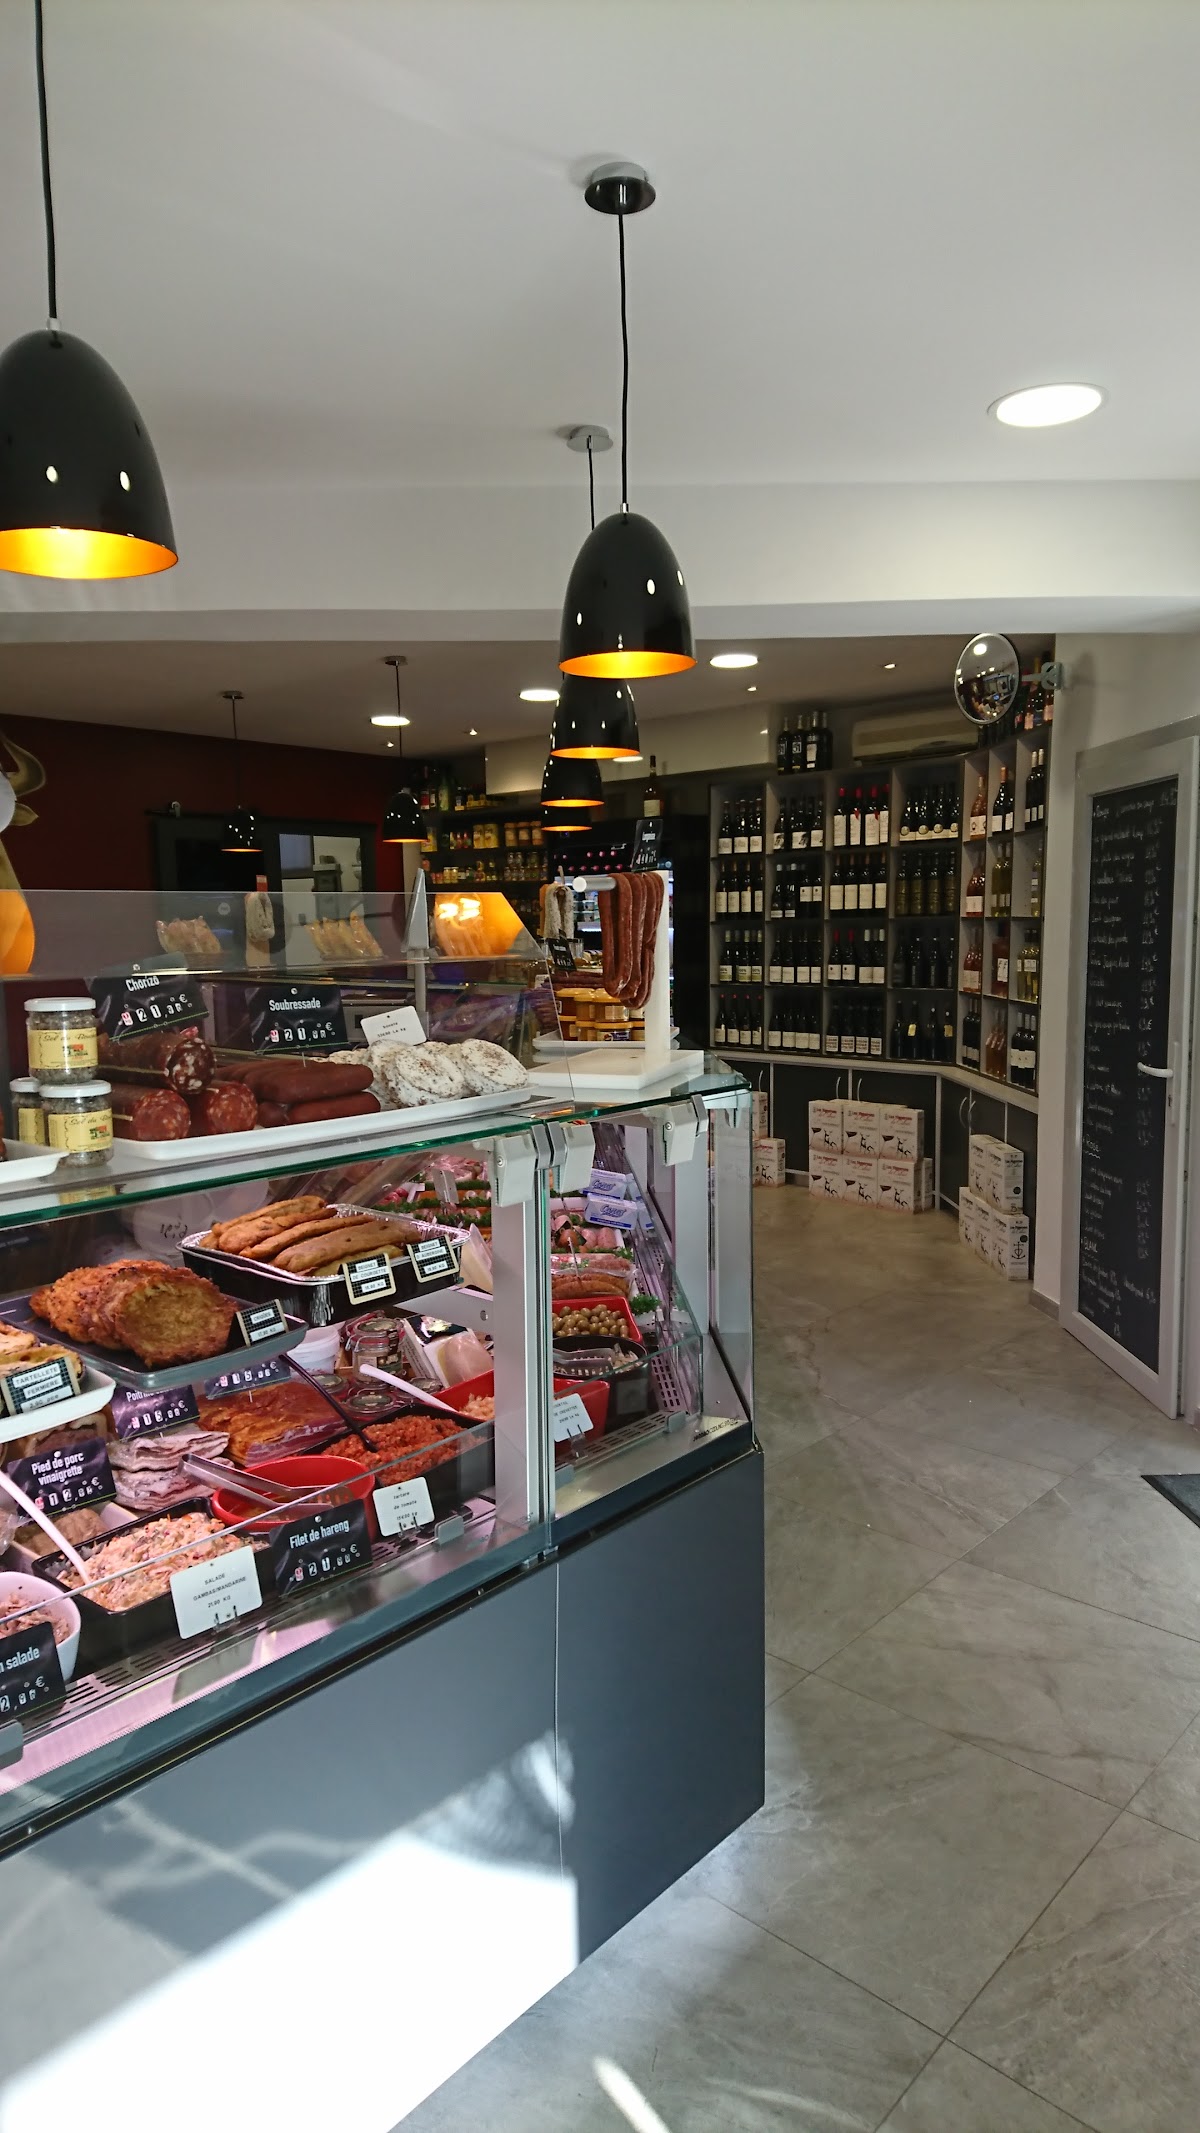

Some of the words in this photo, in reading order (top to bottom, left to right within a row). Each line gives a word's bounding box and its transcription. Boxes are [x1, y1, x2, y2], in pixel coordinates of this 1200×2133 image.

[125, 975, 160, 992] Chorizo
[268, 997, 321, 1012] Soubressade
[15, 1367, 58, 1385] TARTELLETE
[26, 1380, 59, 1396] FERMIERE
[31, 1462, 52, 1475] Pied
[52, 1457, 64, 1469] de
[64, 1453, 85, 1468] porc
[38, 1465, 83, 1487] vinaigrette
[289, 1533, 309, 1549] Filet
[309, 1529, 320, 1542] de
[320, 1520, 350, 1538] hareng
[204, 1573, 226, 1586] SALADE
[5, 1646, 41, 1670] salade
[35, 1675, 46, 1688] €
